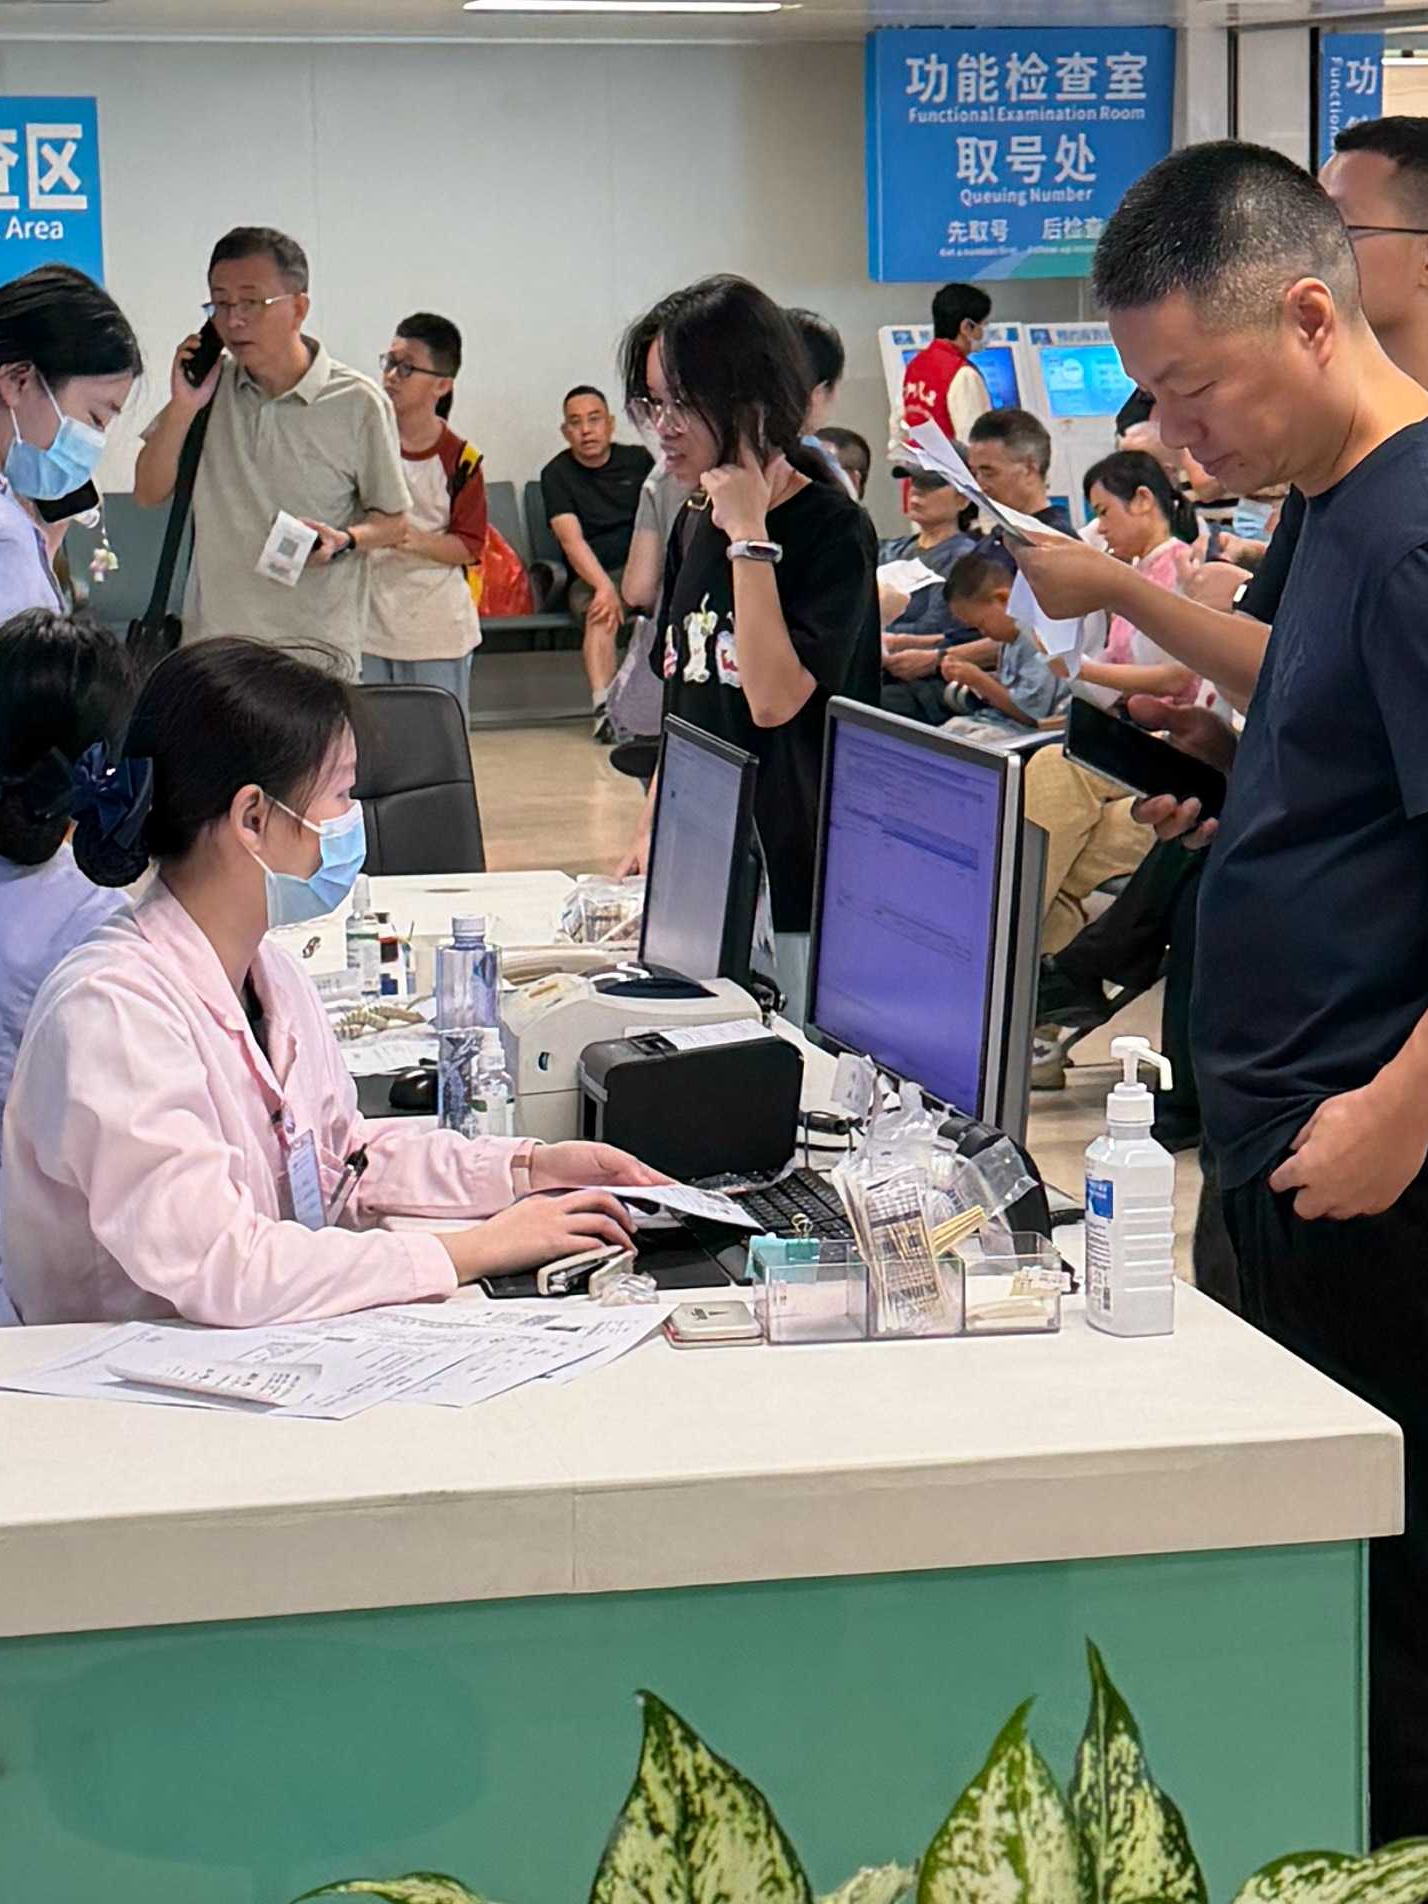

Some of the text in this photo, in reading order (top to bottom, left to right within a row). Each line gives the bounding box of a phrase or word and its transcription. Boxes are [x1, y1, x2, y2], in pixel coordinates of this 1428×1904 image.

[904, 51, 1148, 104] 功能检查室
[908, 105, 1146, 123] Functional Examination Room
[955, 133, 1098, 185] 取号处
[959, 187, 1094, 208] Queuing Number
[4, 215, 64, 240] Area
[948, 216, 1105, 244] 先取号 后检查
